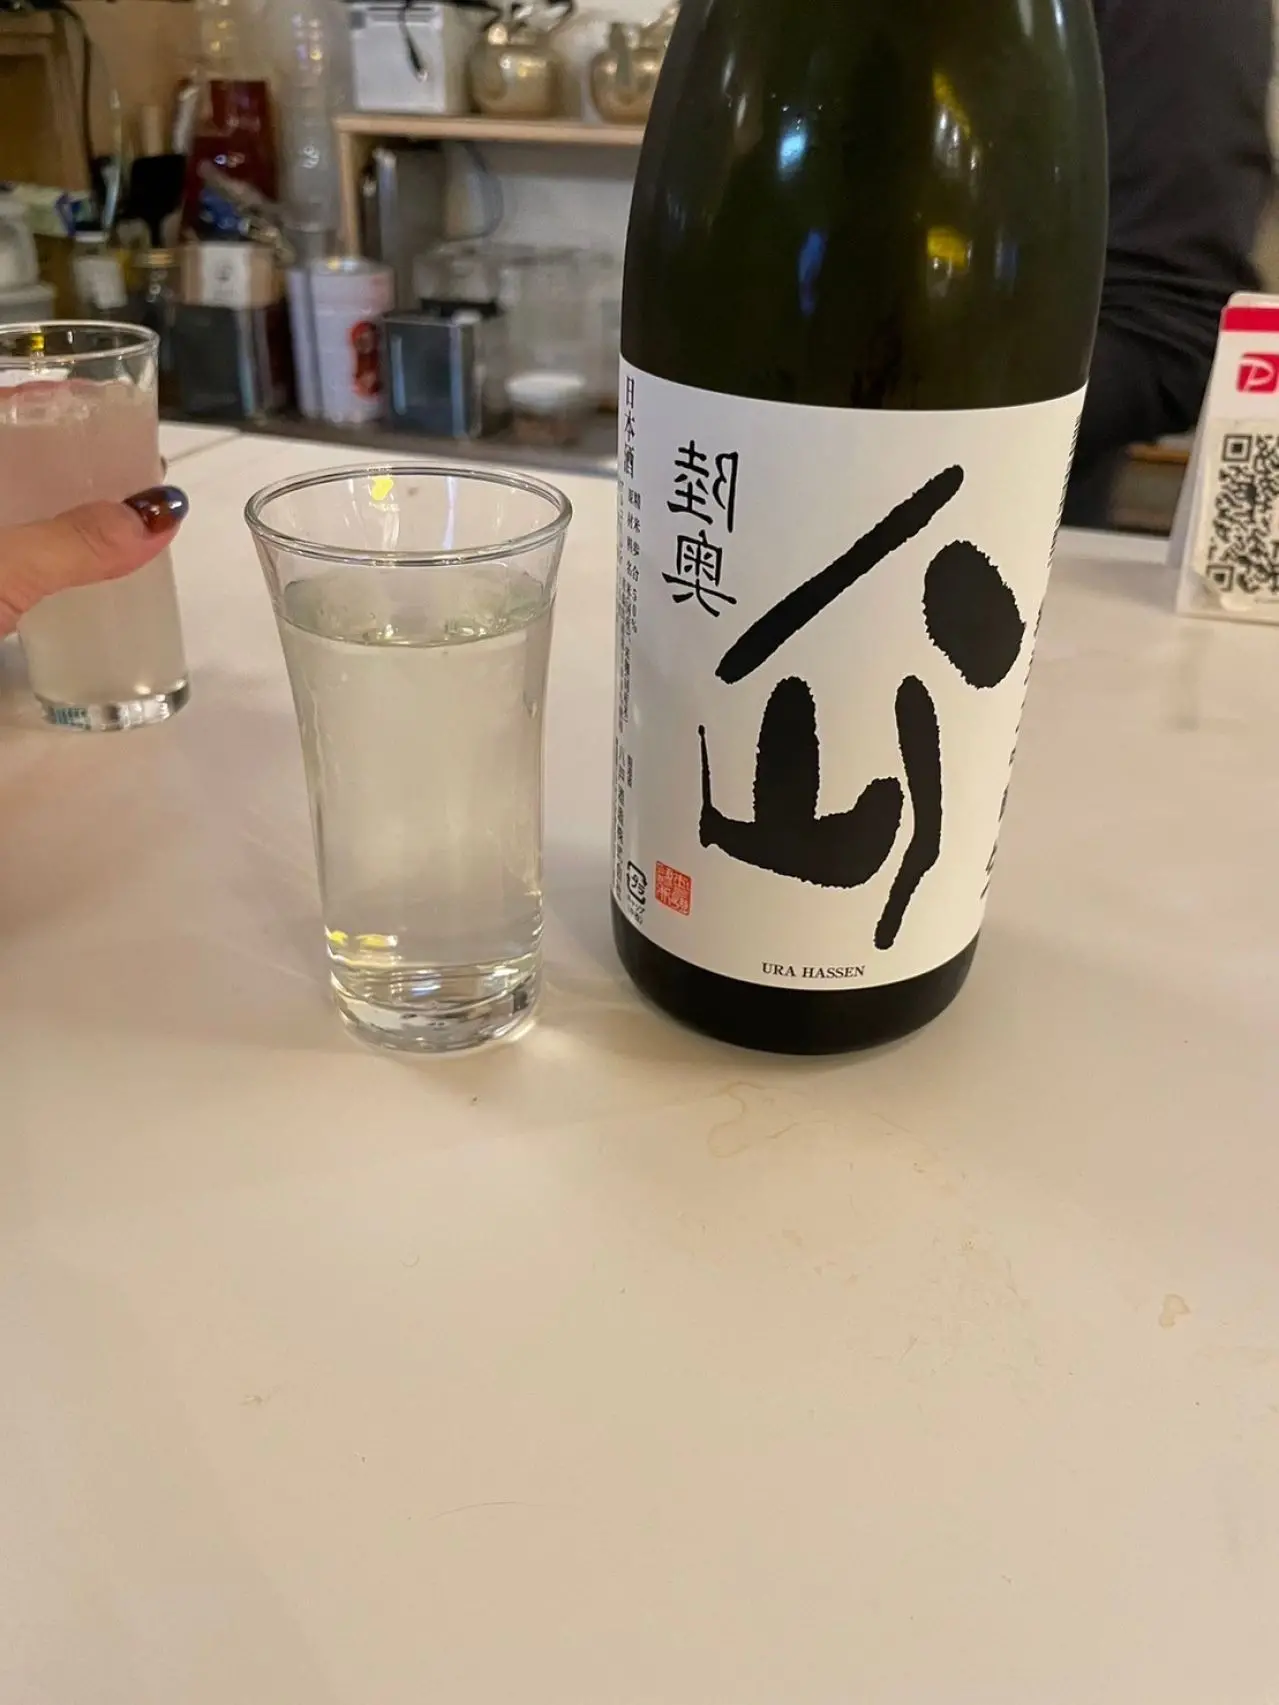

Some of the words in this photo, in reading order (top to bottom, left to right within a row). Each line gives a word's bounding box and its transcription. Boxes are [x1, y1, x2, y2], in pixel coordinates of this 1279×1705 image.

[624, 375, 635, 479] 日本酒
[762, 962, 796, 977] URA
[802, 965, 865, 979] HASSEN
